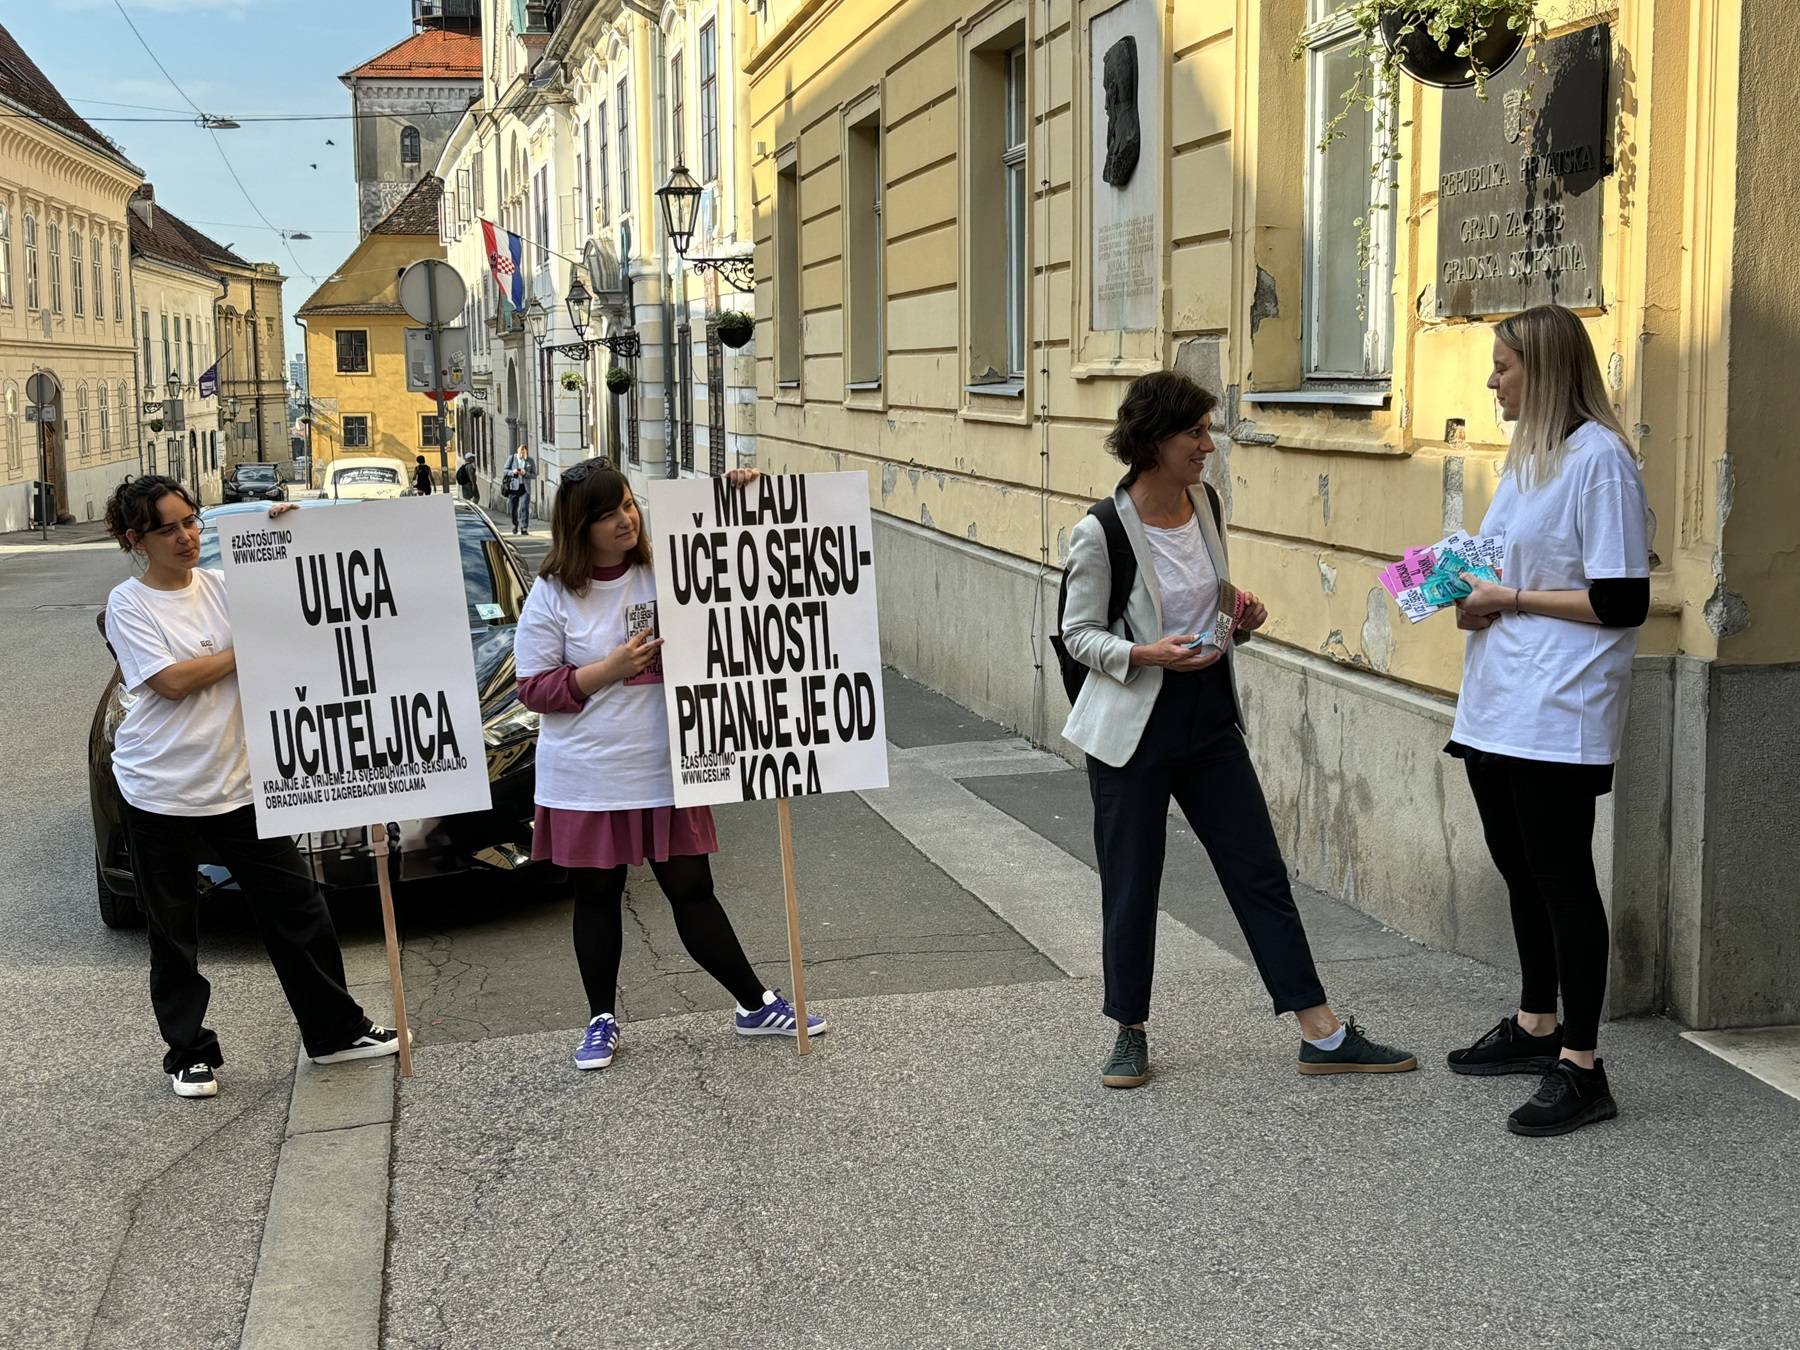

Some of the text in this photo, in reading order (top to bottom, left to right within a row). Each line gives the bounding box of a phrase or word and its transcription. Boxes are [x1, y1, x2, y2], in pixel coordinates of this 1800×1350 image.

[1440, 145, 1594, 198] REPUBLIKA HRVATSKA
[1460, 204, 1566, 244] GRAD ZAGREB
[1442, 239, 1587, 284] GRADSKA SKUPŠTINA
[713, 474, 808, 527] MLADI
[231, 529, 292, 550] #ZAŠTOŠUTIMO
[232, 546, 287, 565] WWW.CESI.HR
[669, 512, 871, 605] UČE O SEKSU-
[295, 548, 398, 626] ULICA
[335, 624, 376, 697] ILI
[707, 601, 839, 679] ALNOSTI.
[270, 686, 460, 780] UČITELJICA
[675, 672, 876, 757] PITANJE JE OD
[263, 757, 467, 794] KRAJNJE JE VRIJEME ZA SVEOBUHVATNO SEKSUALNO
[681, 750, 736, 770] #ZAŠTOŠUTIMO
[681, 767, 730, 785] WWW.CESI.HR
[739, 750, 822, 802] KOGA
[266, 790, 323, 809] OBRAZOVANJE
[324, 789, 330, 802] U
[331, 780, 388, 801] ZAGREBAČKIM
